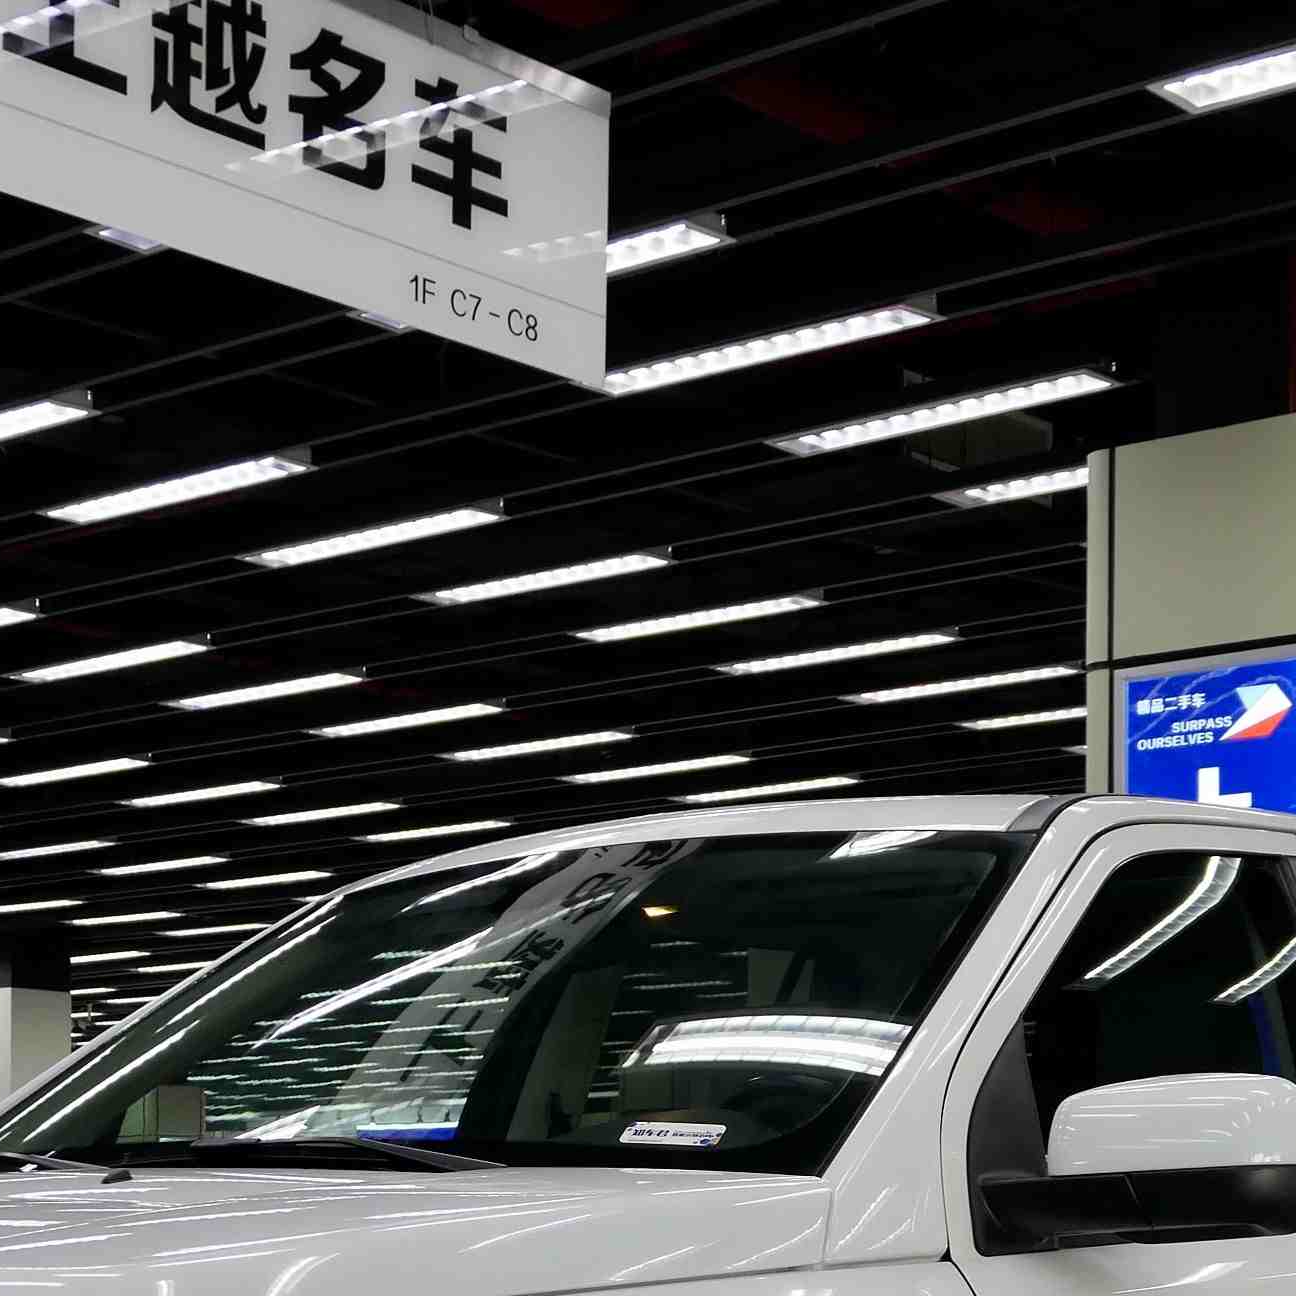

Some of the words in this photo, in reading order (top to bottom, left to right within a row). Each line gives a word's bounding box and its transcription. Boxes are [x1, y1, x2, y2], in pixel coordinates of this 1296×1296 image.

[409, 274, 436, 304] 1F
[1170, 715, 1233, 734] SURPASS
[1136, 731, 1214, 751] OURSELVES
